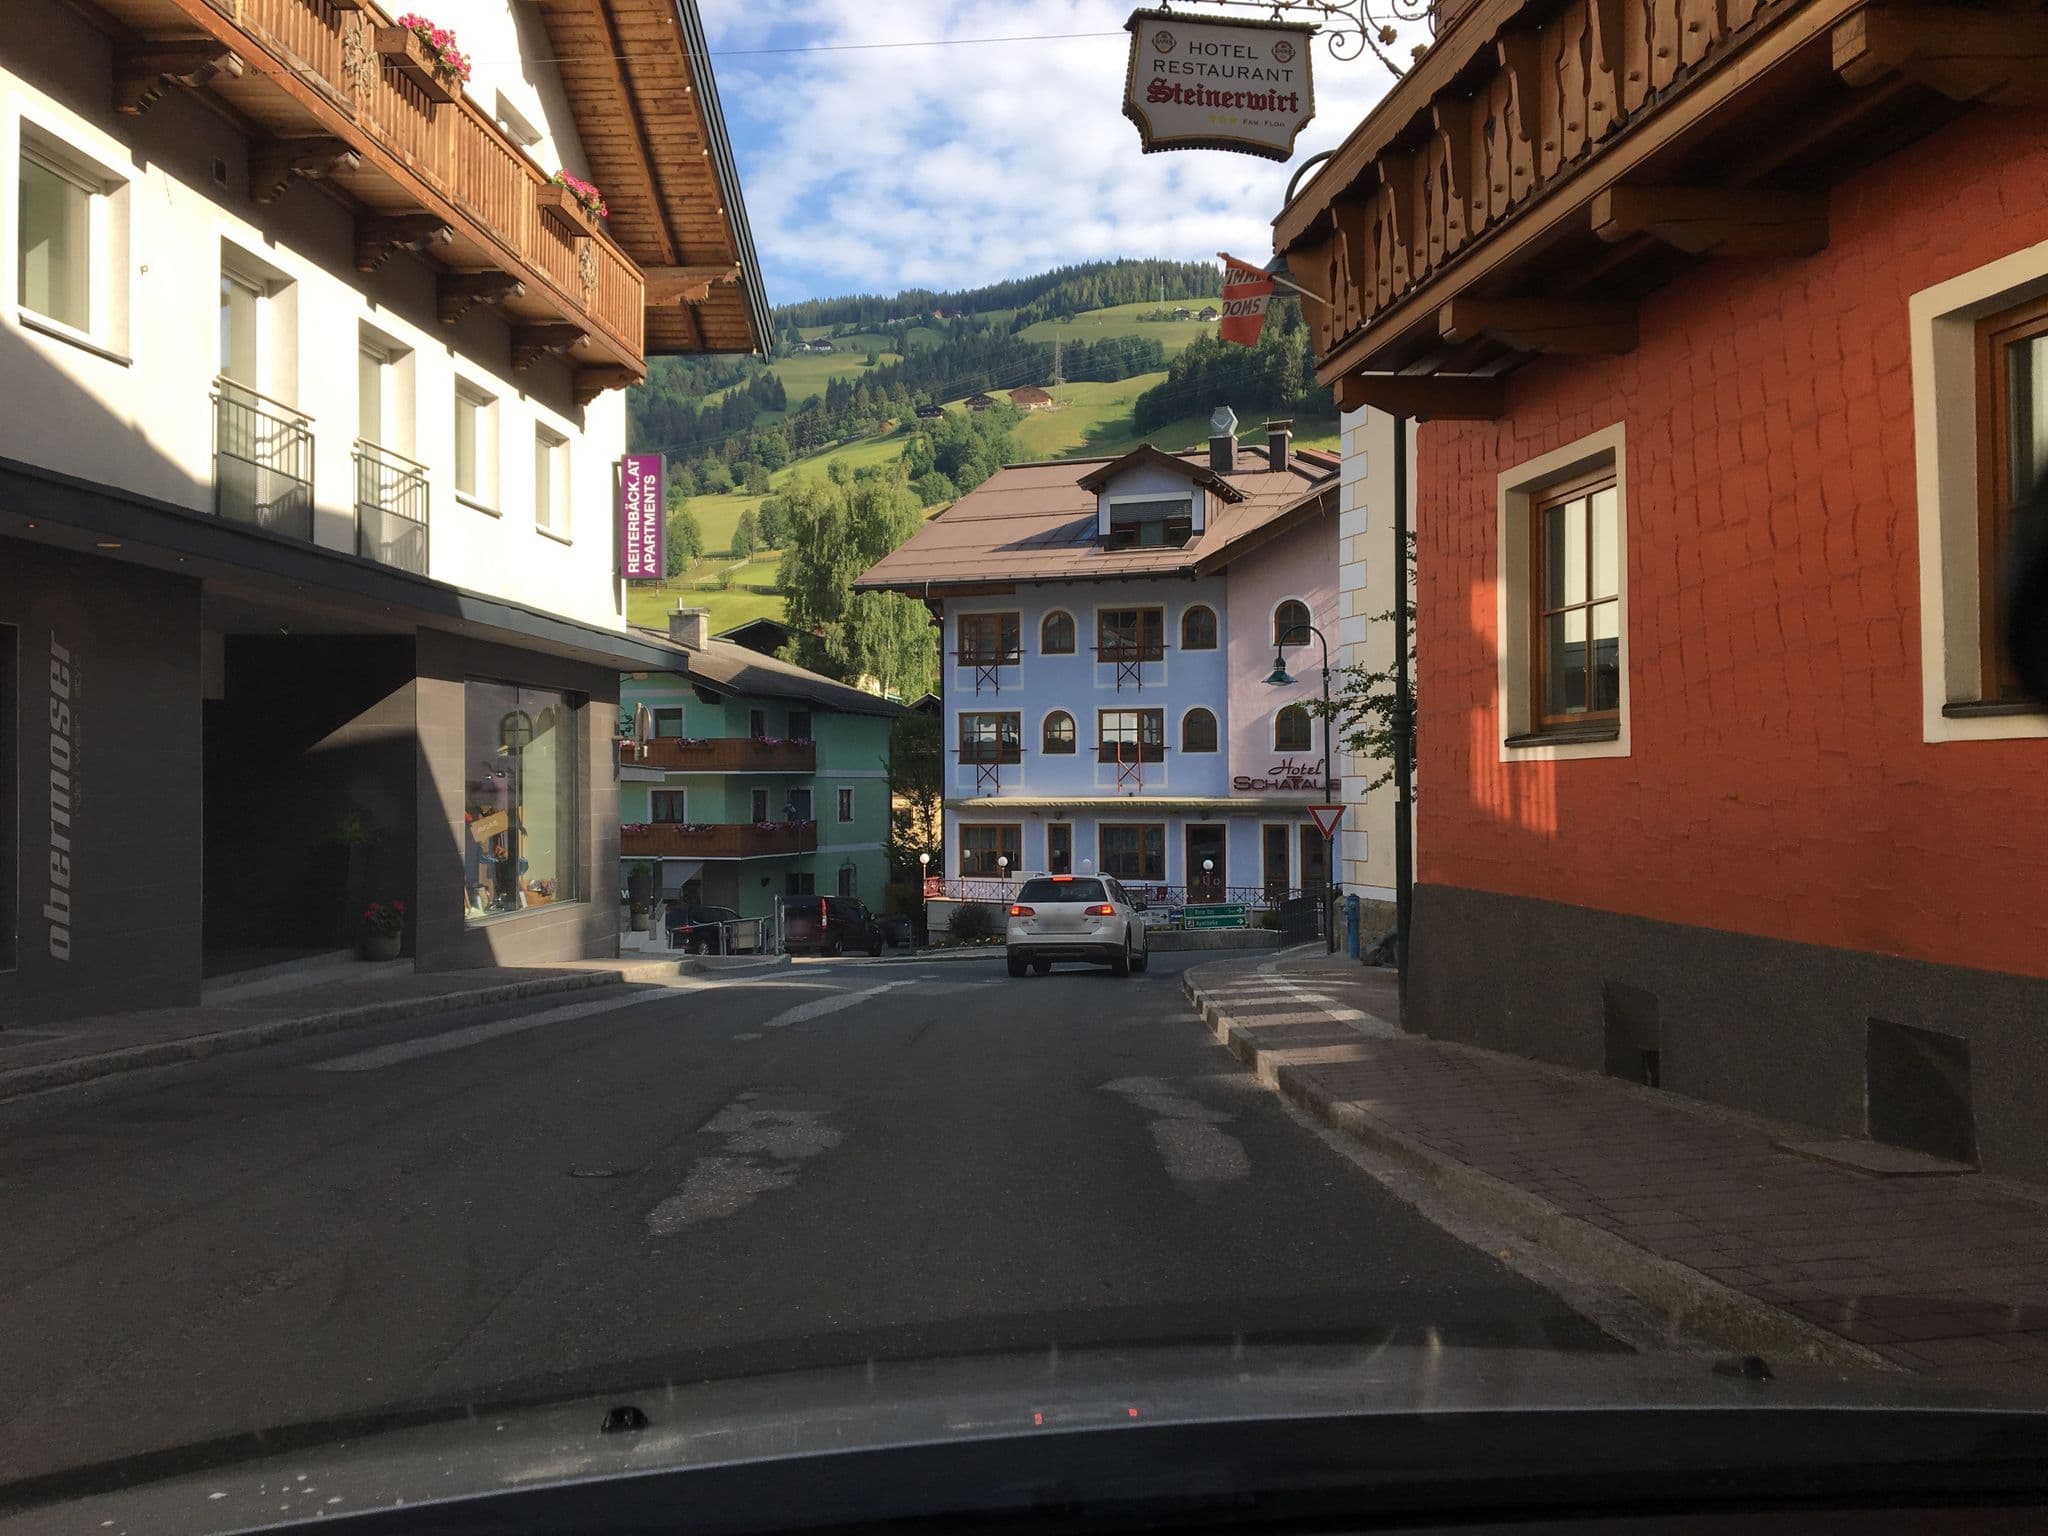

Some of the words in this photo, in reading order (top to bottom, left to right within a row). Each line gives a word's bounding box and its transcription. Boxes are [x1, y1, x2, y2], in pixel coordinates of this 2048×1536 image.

[1189, 41, 1259, 60] HOTEL
[1153, 59, 1293, 82] RESTAURANT
[1146, 77, 1299, 113] Steinerwirt
[625, 459, 640, 573] REITERBÄCK.AT
[644, 474, 656, 573] APARTMENTS
[1268, 757, 1325, 775] Hotel
[43, 629, 71, 960] obermoser
